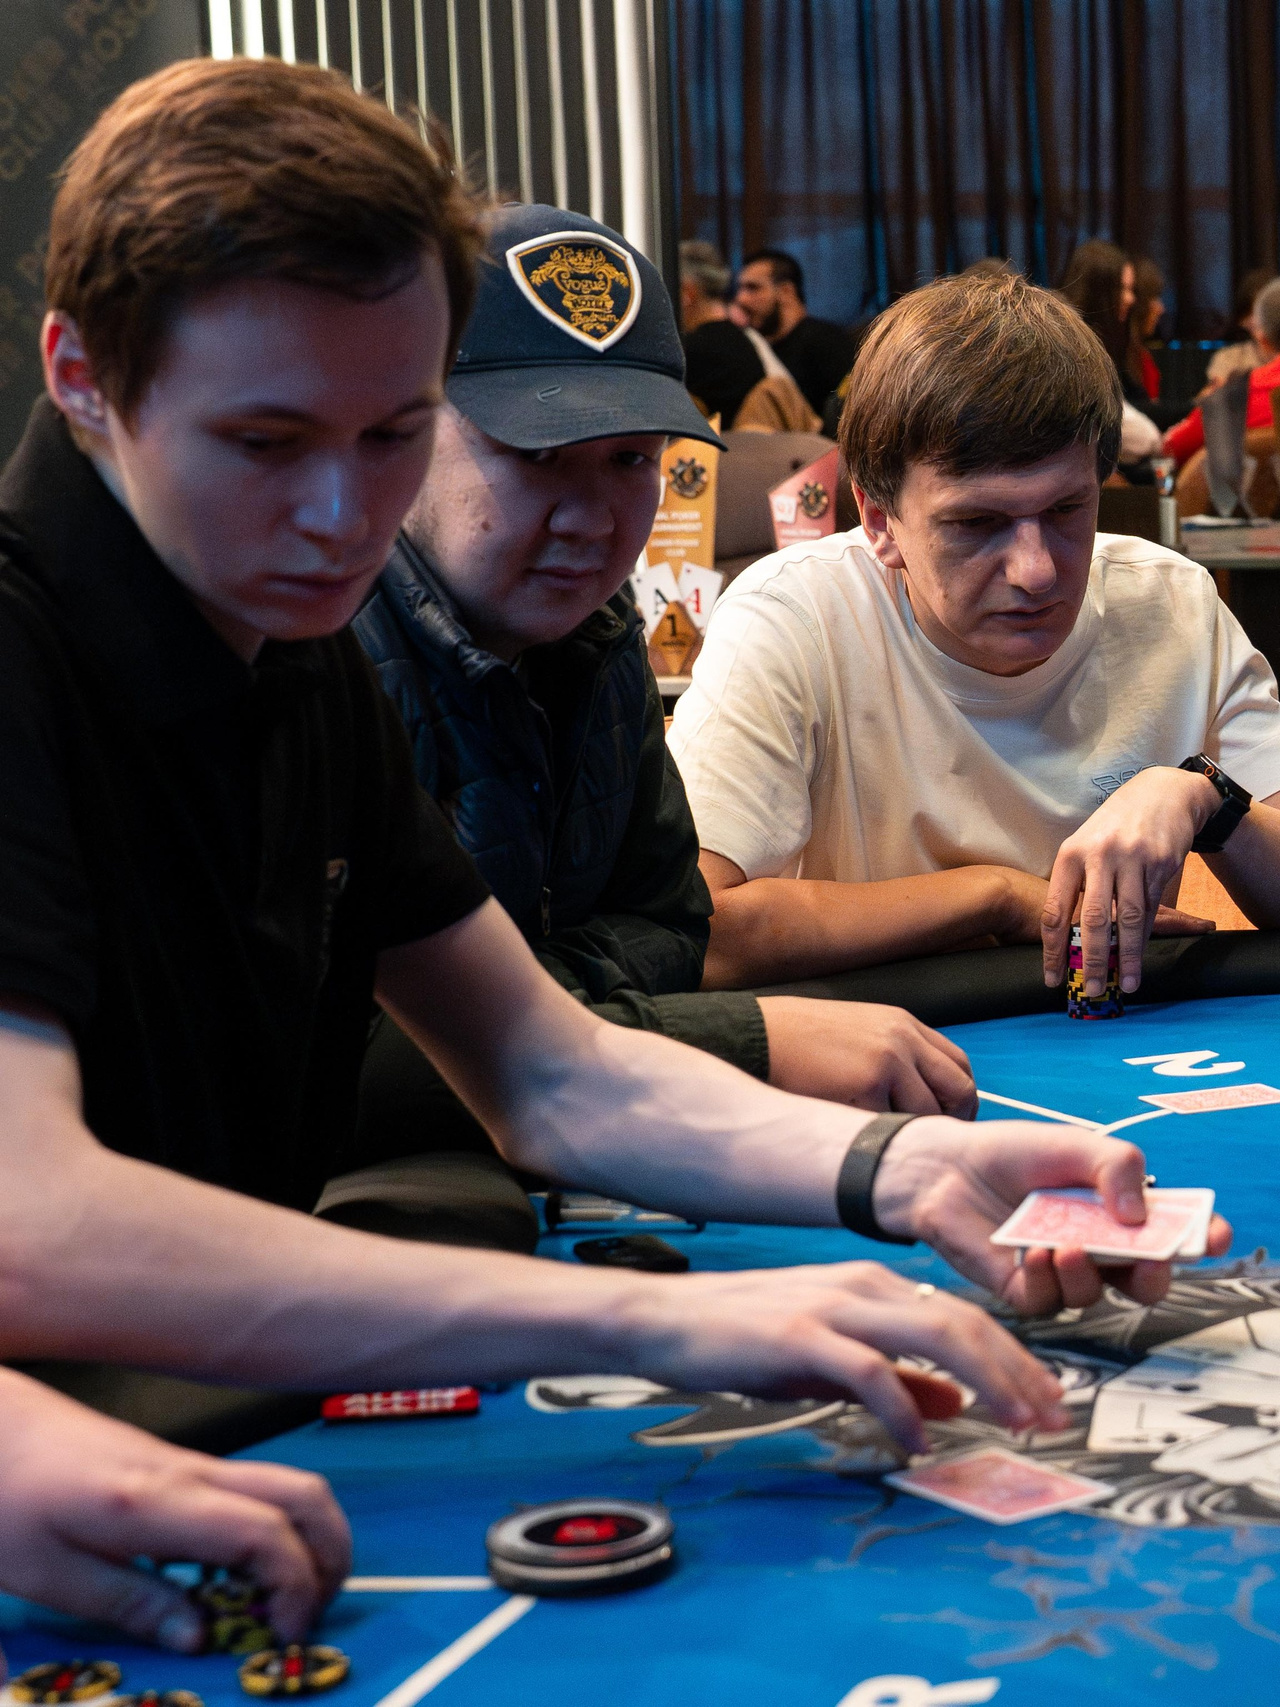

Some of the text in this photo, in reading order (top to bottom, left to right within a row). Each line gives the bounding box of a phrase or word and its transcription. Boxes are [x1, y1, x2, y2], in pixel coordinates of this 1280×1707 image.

[0, 36, 67, 131] OKER
[666, 613, 678, 637] 1
[1122, 1050, 1246, 1077] 2
